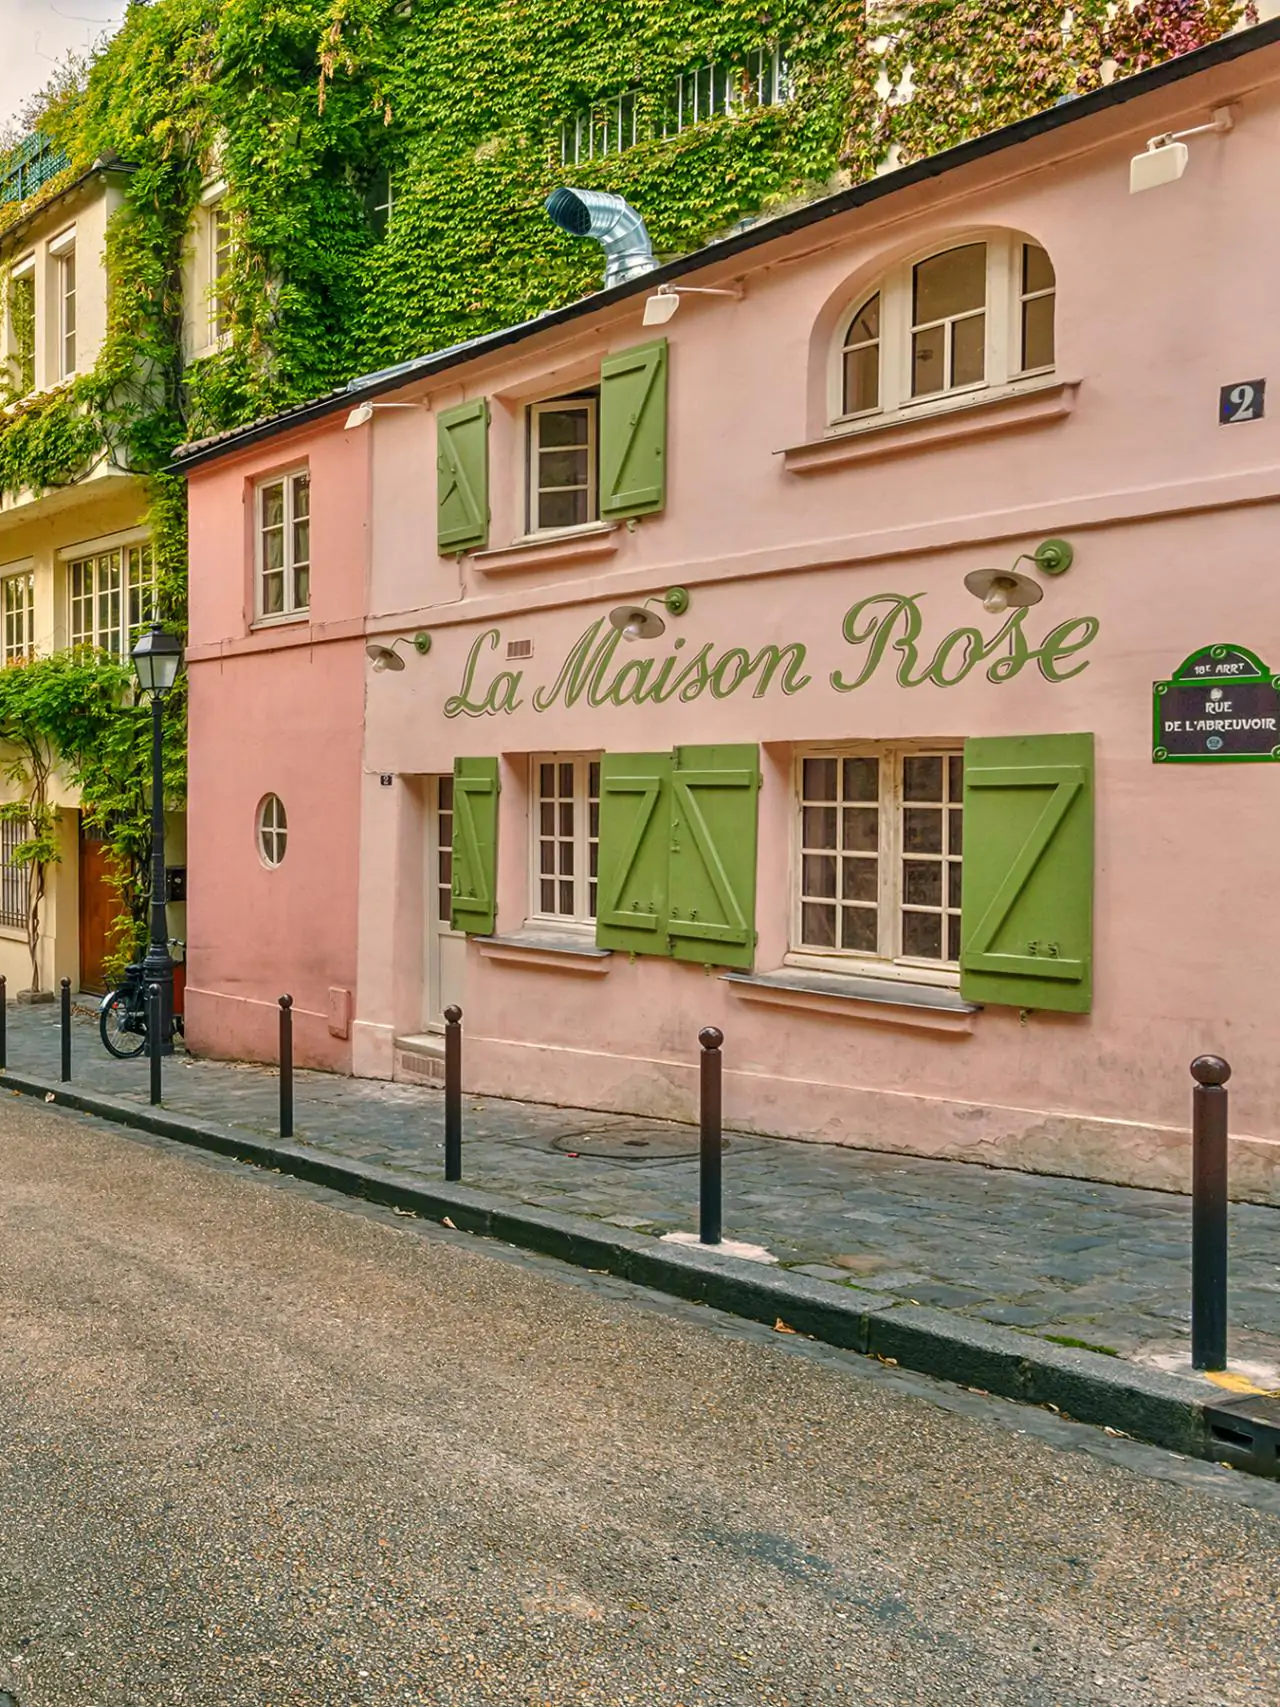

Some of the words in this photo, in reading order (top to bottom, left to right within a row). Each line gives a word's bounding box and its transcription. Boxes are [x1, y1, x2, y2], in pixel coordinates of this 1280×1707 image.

[1229, 385, 1254, 421] 2
[444, 629, 524, 718] La
[531, 617, 811, 712] Maison
[830, 592, 1100, 694] Rose
[1205, 702, 1232, 714] RUE
[1165, 721, 1182, 732] DE
[1186, 718, 1277, 731] L'ABREUVOIR
